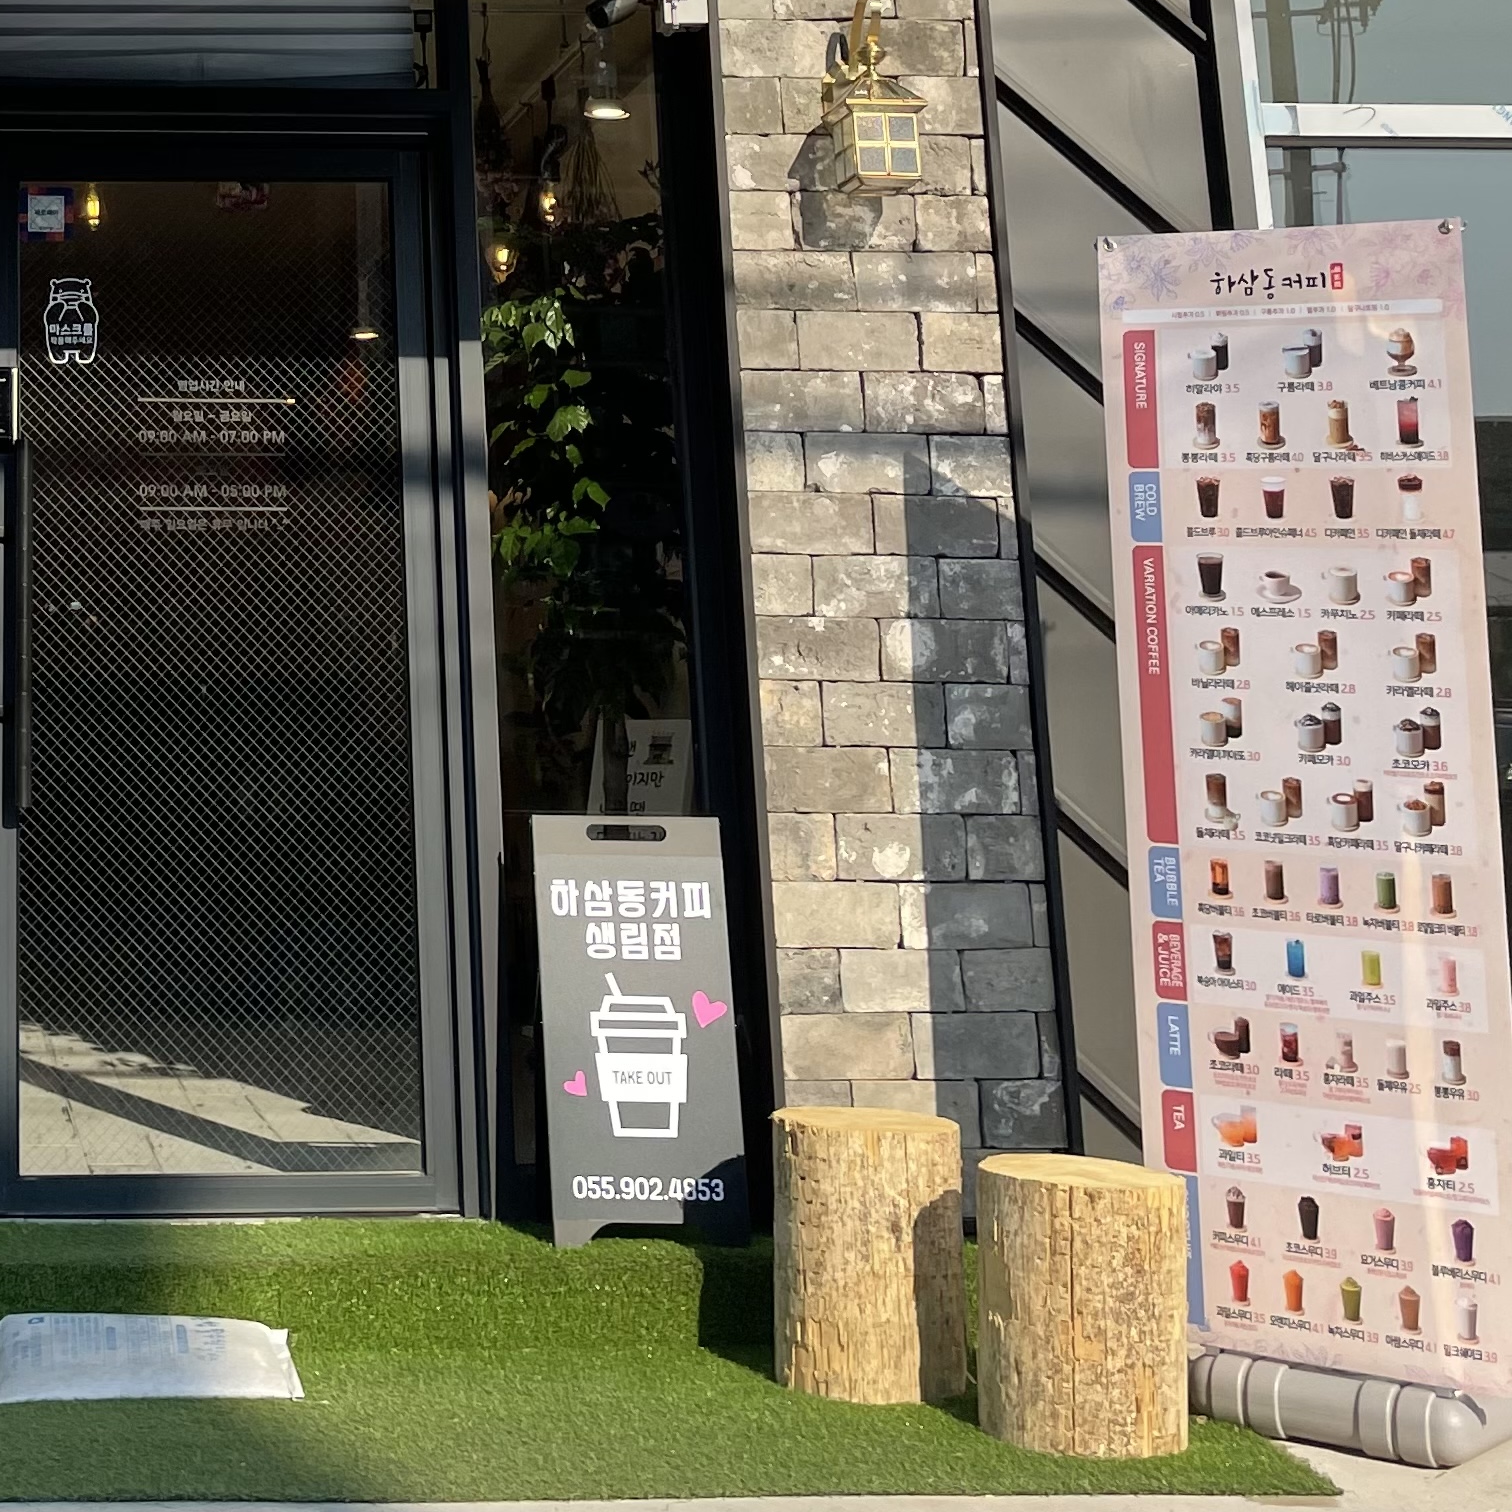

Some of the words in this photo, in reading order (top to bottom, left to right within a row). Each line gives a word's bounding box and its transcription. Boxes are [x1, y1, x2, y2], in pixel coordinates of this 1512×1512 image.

[49, 323, 93, 336] 마스크를
[1133, 342, 1147, 409] SIGNATURE
[1225, 383, 1240, 393] 3.5
[1318, 381, 1333, 391] 3.8
[1428, 379, 1442, 388] 4.1
[183, 430, 206, 443] AM
[263, 430, 285, 443] PM
[1221, 452, 1236, 463] 3.5
[183, 484, 207, 497] AM
[1133, 484, 1146, 521] BREW
[1145, 483, 1157, 516] COLD
[1304, 528, 1317, 537] 4.5
[1142, 557, 1157, 625] VARIATION
[1231, 606, 1244, 616] 1.5
[1298, 608, 1311, 618] 1.5
[1360, 610, 1375, 620] 2.5
[1426, 611, 1442, 622] 2.5
[1146, 626, 1160, 675] COFFEE
[1247, 751, 1261, 762] 3.0
[1336, 755, 1351, 766] 3.0
[1432, 760, 1448, 772] 3.6
[1308, 835, 1321, 846] 3.5
[1376, 840, 1389, 851] 3.5
[1153, 858, 1164, 883] TEA
[1164, 856, 1179, 907] BUBBLE
[549, 878, 713, 919] 하삼동커피
[584, 920, 683, 962] 생림점
[1157, 932, 1166, 943] &
[1158, 944, 1170, 986] JUICE
[1168, 933, 1183, 988] BEVERAGE
[1245, 980, 1257, 991] 3.0
[1302, 986, 1314, 997] 3.5
[1167, 1015, 1180, 1056] LATTE
[1246, 1064, 1260, 1075] 3.0
[1294, 1070, 1309, 1081] 3.5
[612, 1069, 644, 1087] TAKE
[646, 1068, 673, 1086] OUT
[1356, 1078, 1369, 1088] 3.5
[1408, 1083, 1422, 1094] 2.5
[1173, 1104, 1185, 1131] TEA
[1246, 1153, 1261, 1164] 3.5
[1353, 1168, 1369, 1179] 2.5
[572, 1174, 725, 1204] 055.902.4853
[1458, 1182, 1475, 1194] 2.5
[1324, 1247, 1337, 1259] 3.9
[1400, 1260, 1414, 1272] 3.9
[1488, 1273, 1501, 1285] 4.1
